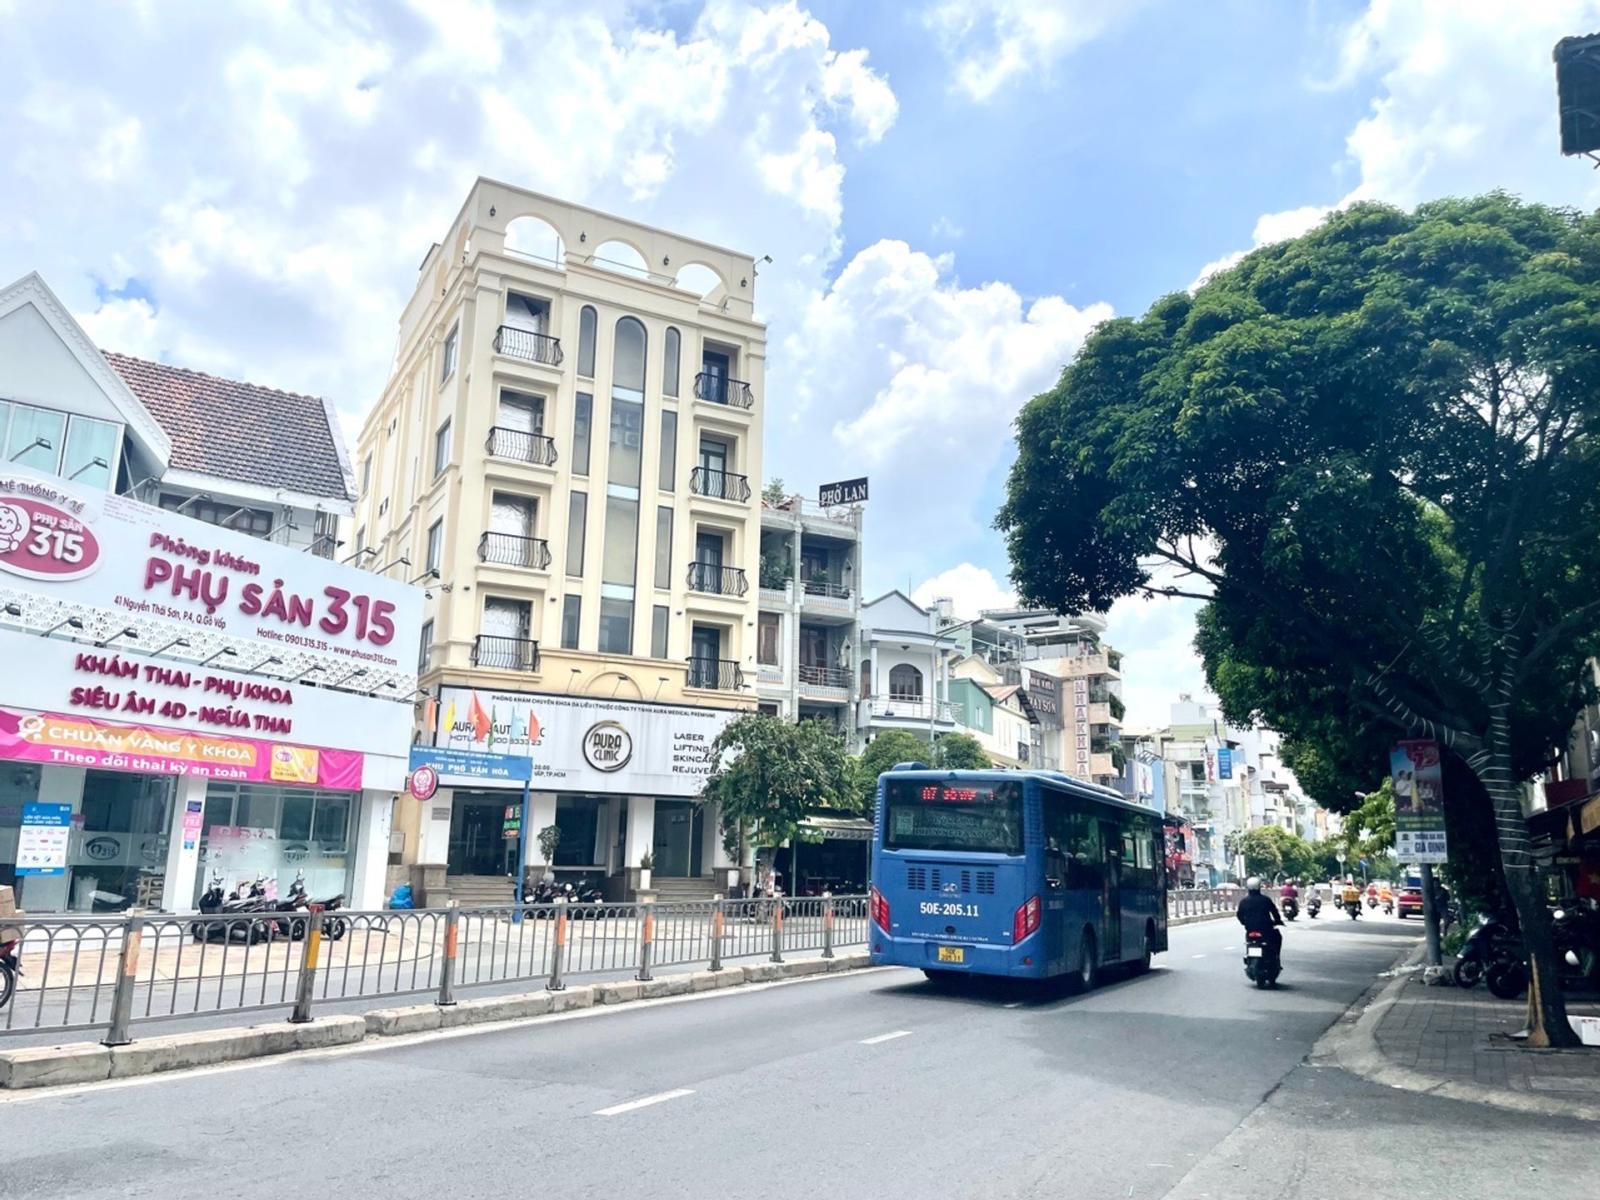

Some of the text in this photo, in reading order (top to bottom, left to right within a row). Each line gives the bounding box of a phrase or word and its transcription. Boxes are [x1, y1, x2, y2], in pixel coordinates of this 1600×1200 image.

[19, 482, 58, 499] THỐNG
[60, 495, 69, 504] Y
[70, 500, 86, 514] TẾ
[844, 484, 866, 502] LAN
[59, 518, 83, 533] SẢN
[28, 525, 84, 563] 315
[213, 549, 260, 575] khám
[114, 595, 122, 605] 41
[152, 603, 166, 616] Thái
[144, 557, 396, 646] PHỤ SẢN 315
[257, 627, 283, 641] Hotline:
[285, 633, 328, 651] 0901.315.315
[333, 646, 398, 665] www.phusan315.com
[75, 653, 139, 679] KHÁM
[144, 665, 191, 688] THAI
[204, 676, 243, 700] PHỤ
[244, 683, 293, 705] KHOA
[70, 685, 120, 709] SIÊU
[122, 687, 156, 714] ÂM
[159, 701, 187, 718] 4D
[254, 714, 292, 733] THAI
[48, 727, 124, 746] CHUẨN
[187, 743, 197, 754] Y
[202, 745, 252, 761] KHOA
[593, 732, 622, 750] AURA
[673, 744, 709, 752] LIFTING
[674, 733, 704, 741] LASER
[50, 748, 248, 778] Theo dõi thai kỳ an toàn
[593, 748, 620, 761] CLINIC
[920, 902, 979, 917] 50E-205.11
